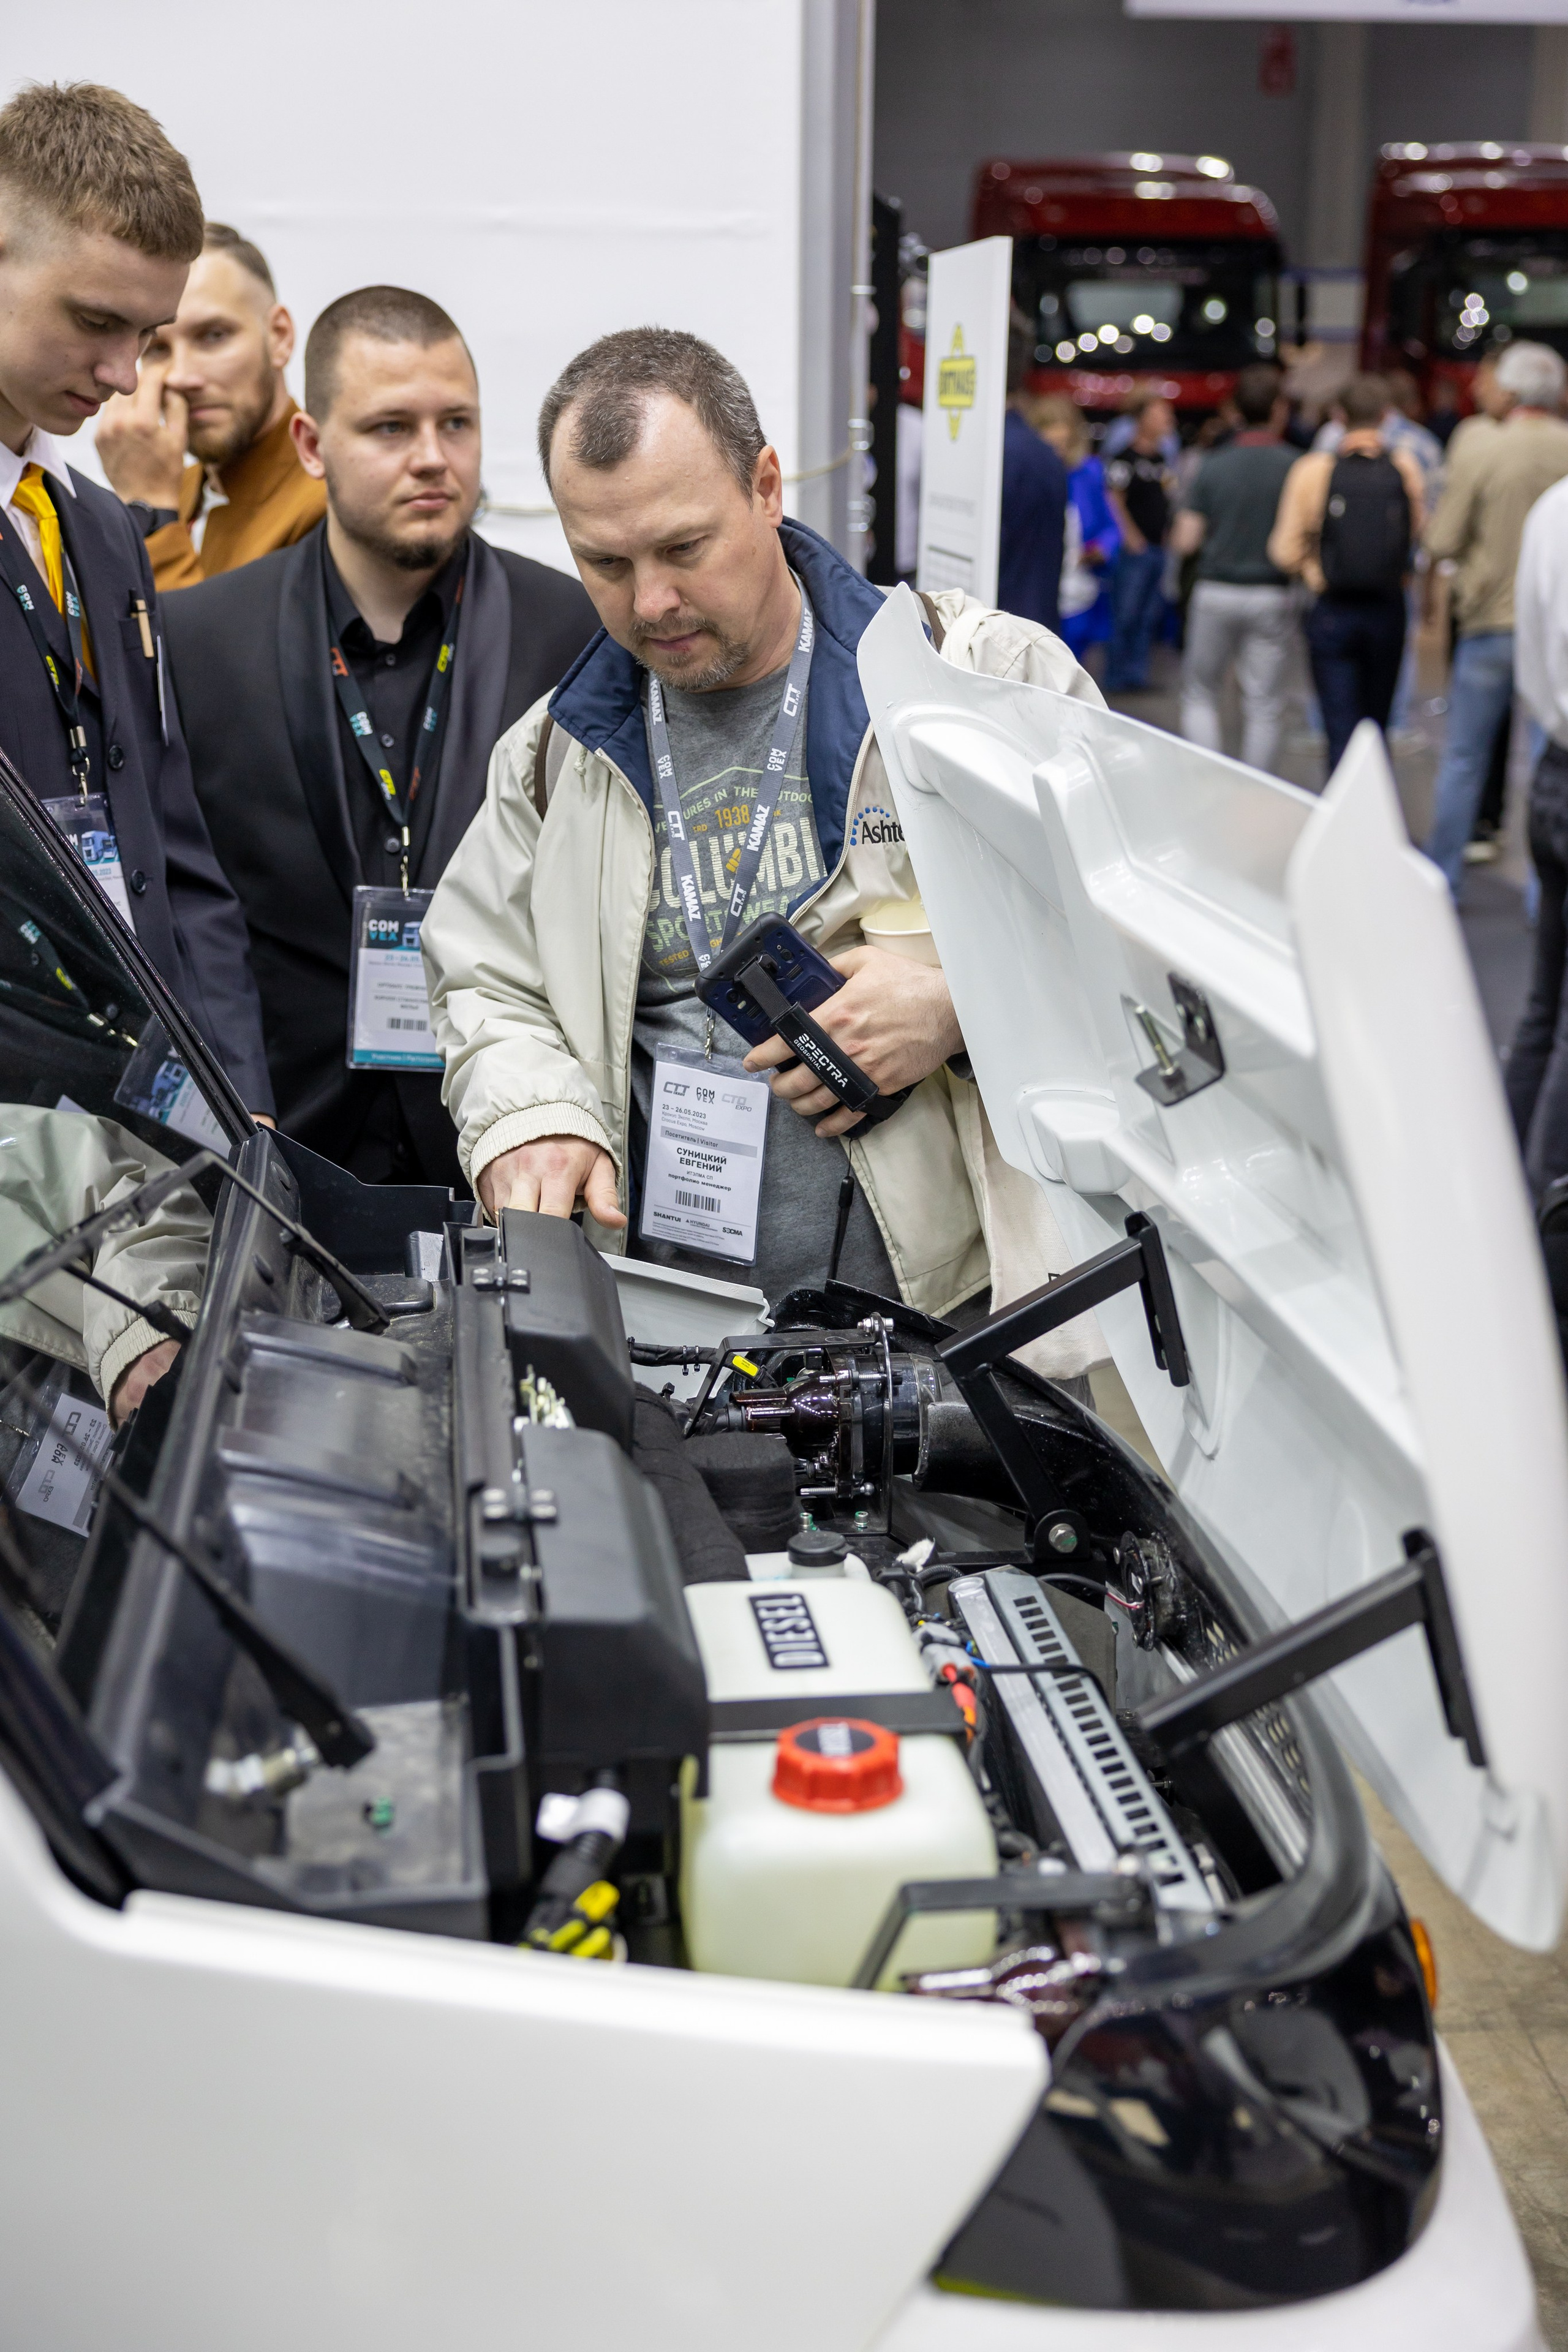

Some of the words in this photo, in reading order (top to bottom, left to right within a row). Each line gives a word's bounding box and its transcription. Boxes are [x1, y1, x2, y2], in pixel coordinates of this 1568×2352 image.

[798, 608, 813, 652] KAMAZ
[650, 679, 662, 725] KAMAZ
[783, 682, 797, 717] CTT
[657, 756, 667, 779] VEX
[662, 754, 673, 777] COM
[767, 748, 780, 771] COM
[774, 750, 787, 772] VEX
[715, 789, 728, 802] IN
[734, 786, 758, 798] THE
[668, 811, 685, 840] CTT
[715, 804, 750, 828] 1938
[747, 804, 770, 851] KAMAZ
[680, 874, 701, 922] KAMAZ
[731, 883, 744, 918] CTT
[369, 919, 399, 933] COM
[794, 1039, 821, 1071] GEOSPATIAL
[799, 1033, 848, 1088] SPECTRA
[663, 1082, 690, 1095] CTT
[696, 1087, 715, 1097] COM
[697, 1094, 714, 1104] VEX
[676, 1107, 706, 1118] 26.05.2023
[665, 1130, 696, 1142] Посетитель
[700, 1139, 718, 1147] Visitor
[677, 1147, 727, 1164] СУНИЦКИЙ
[679, 1157, 722, 1172] ЕВГЕНИЙ
[668, 1173, 699, 1185] портфолио
[701, 1180, 731, 1191] менеджер
[654, 1212, 681, 1222] SHANTUI
[755, 1595, 825, 1667] DIESEL
